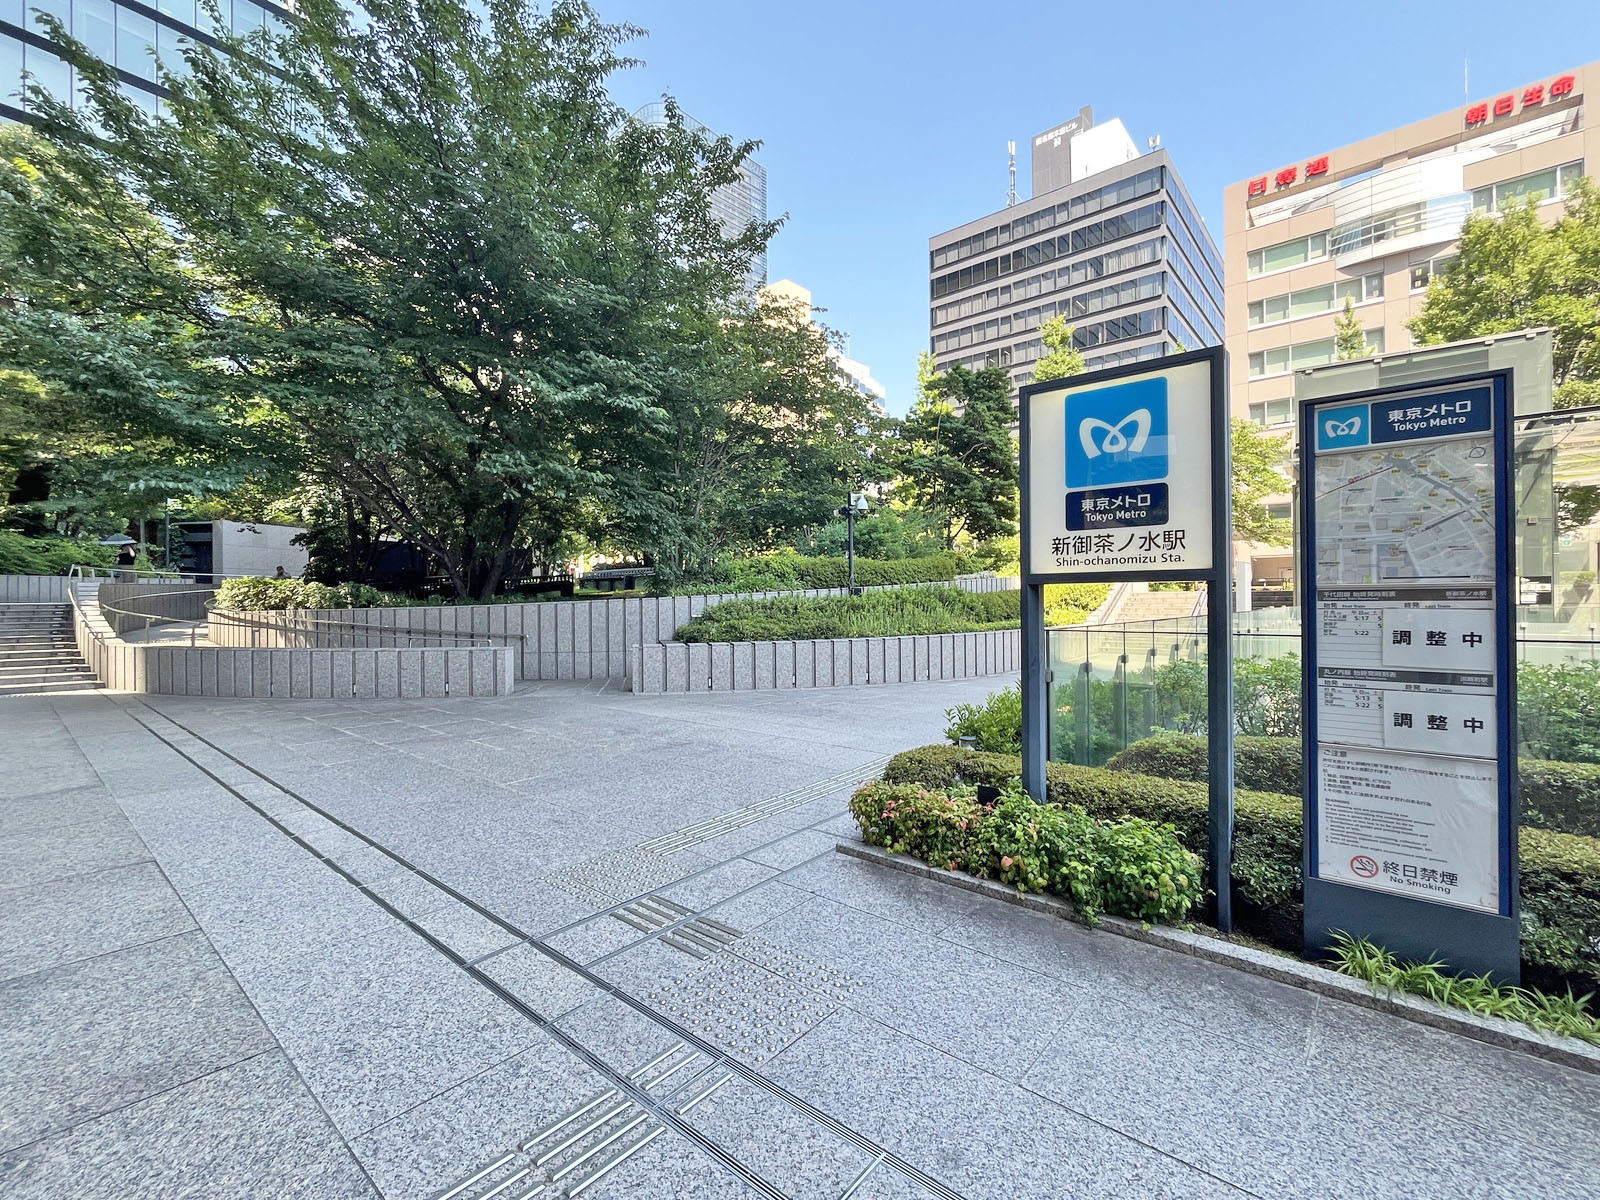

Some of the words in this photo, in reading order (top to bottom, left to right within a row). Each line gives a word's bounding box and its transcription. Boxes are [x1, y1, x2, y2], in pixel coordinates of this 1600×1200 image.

[1466, 75, 1576, 125] 朝日生命
[1248, 156, 1329, 196] 日専連
[1388, 400, 1471, 423] 東京メトロ
[1393, 421, 1427, 432] Tokyo
[1429, 415, 1466, 428] Metro
[1081, 493, 1151, 512] 東京メトロ
[1085, 512, 1114, 523] Tokyo
[1116, 509, 1147, 520] Metro
[1051, 529, 1186, 556] 新御茶ノ水駅
[1056, 554, 1157, 567] Shin-ochanomizu
[1161, 553, 1185, 563] Sta.
[1392, 630, 1483, 648] 調整中
[1393, 712, 1484, 734] 調整中
[1382, 860, 1458, 888] 終日禁煙
[1390, 875, 1404, 884] No
[1406, 878, 1451, 895] Smoking
